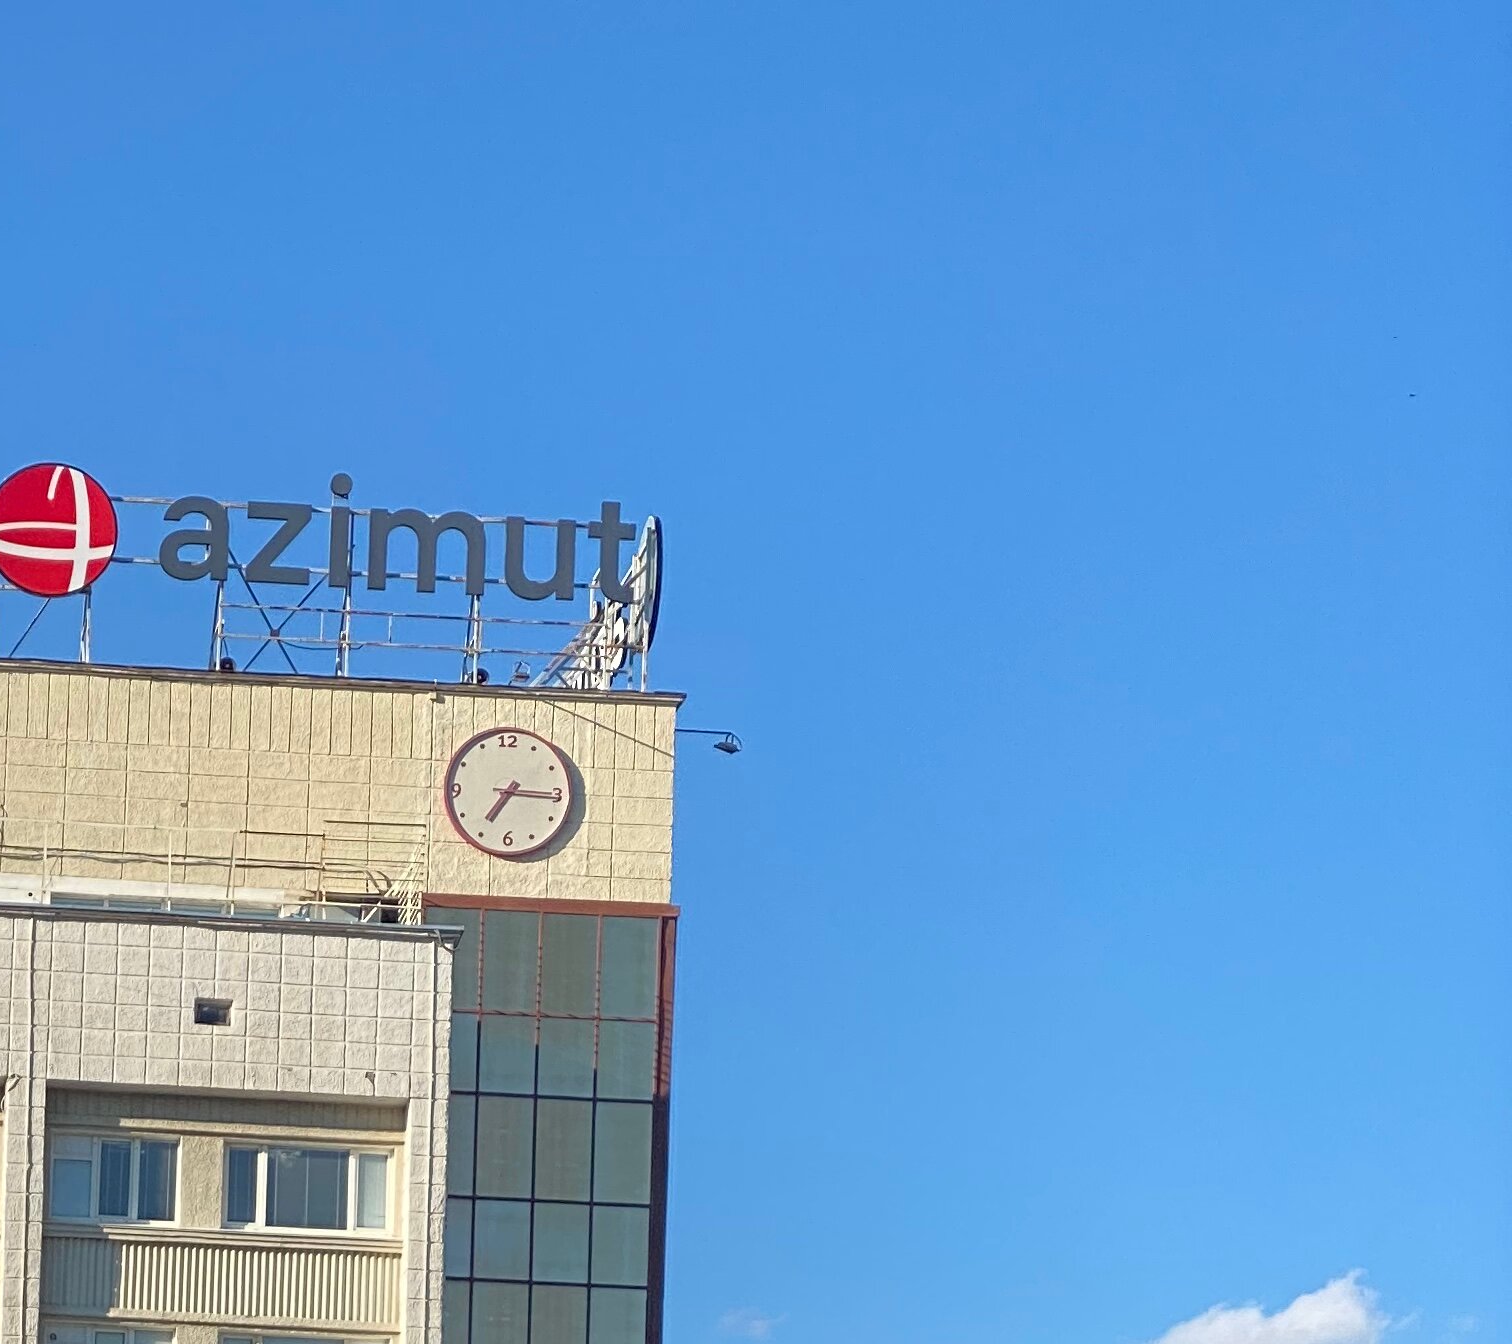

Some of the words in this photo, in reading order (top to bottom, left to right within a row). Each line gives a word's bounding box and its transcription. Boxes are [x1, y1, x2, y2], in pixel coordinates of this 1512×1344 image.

[158, 472, 637, 605] azimut
[497, 734, 518, 748] 12
[450, 783, 462, 799] 9
[552, 787, 563, 803] 3
[502, 830, 514, 847] 6
